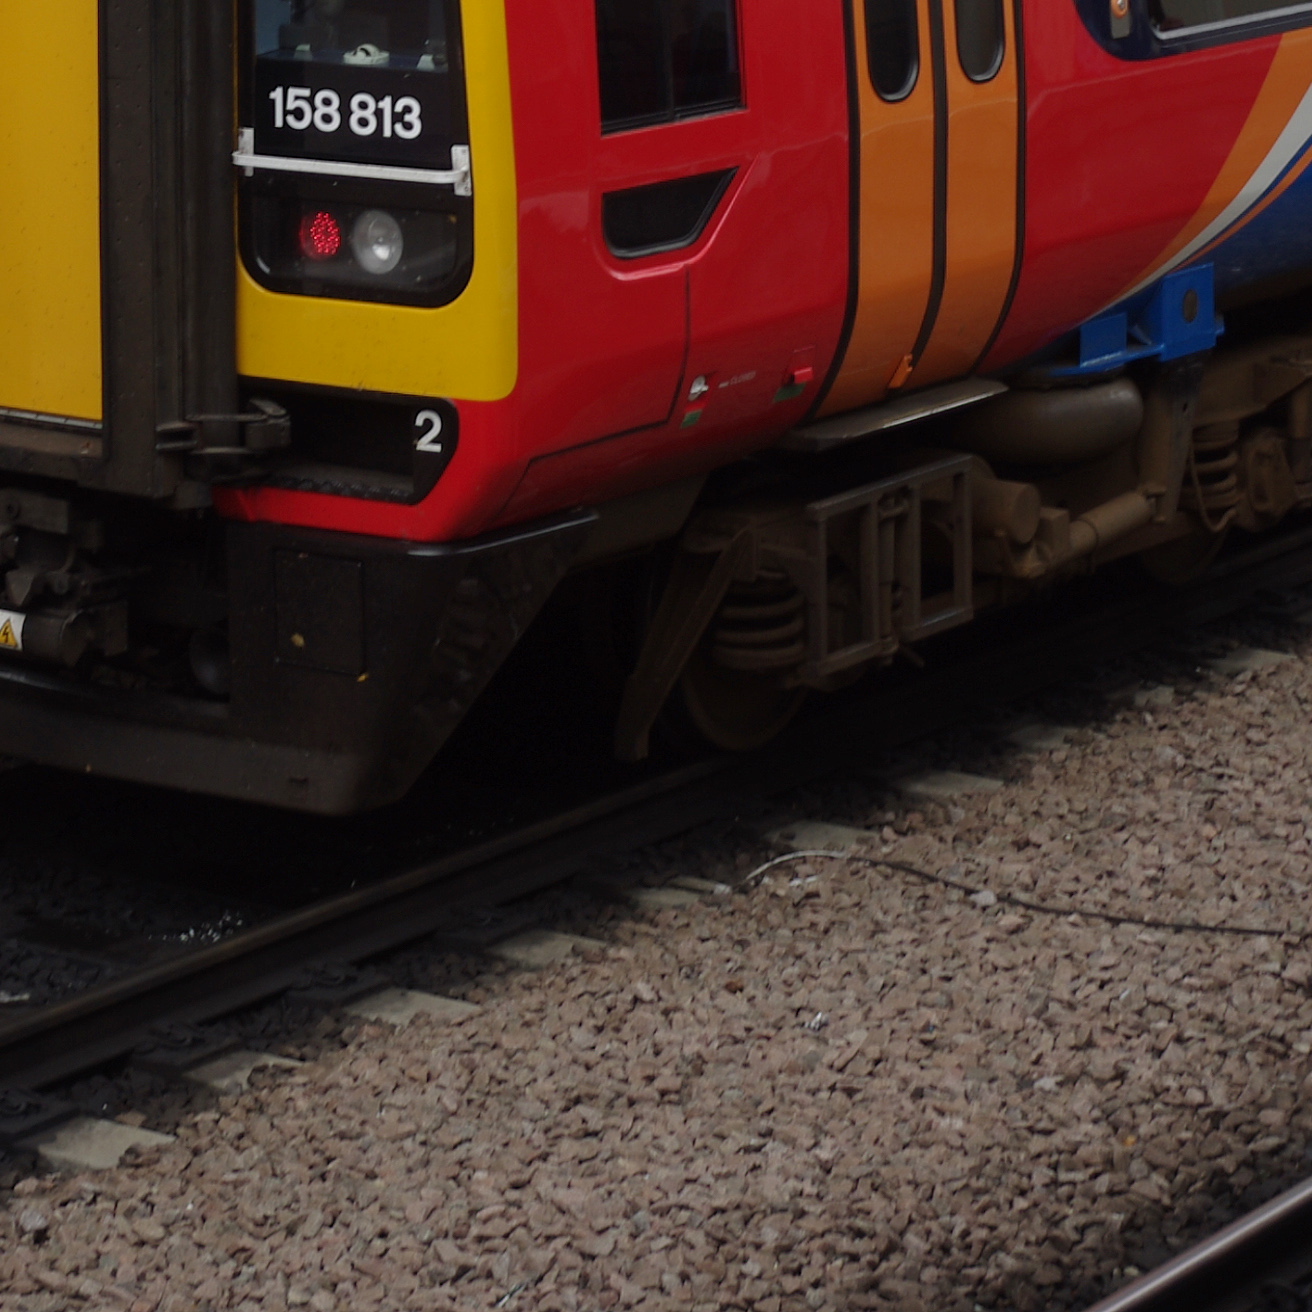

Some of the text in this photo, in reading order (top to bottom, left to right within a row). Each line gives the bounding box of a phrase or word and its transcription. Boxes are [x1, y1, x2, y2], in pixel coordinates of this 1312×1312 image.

[268, 84, 423, 141] 158 813
[413, 408, 444, 454] 2
